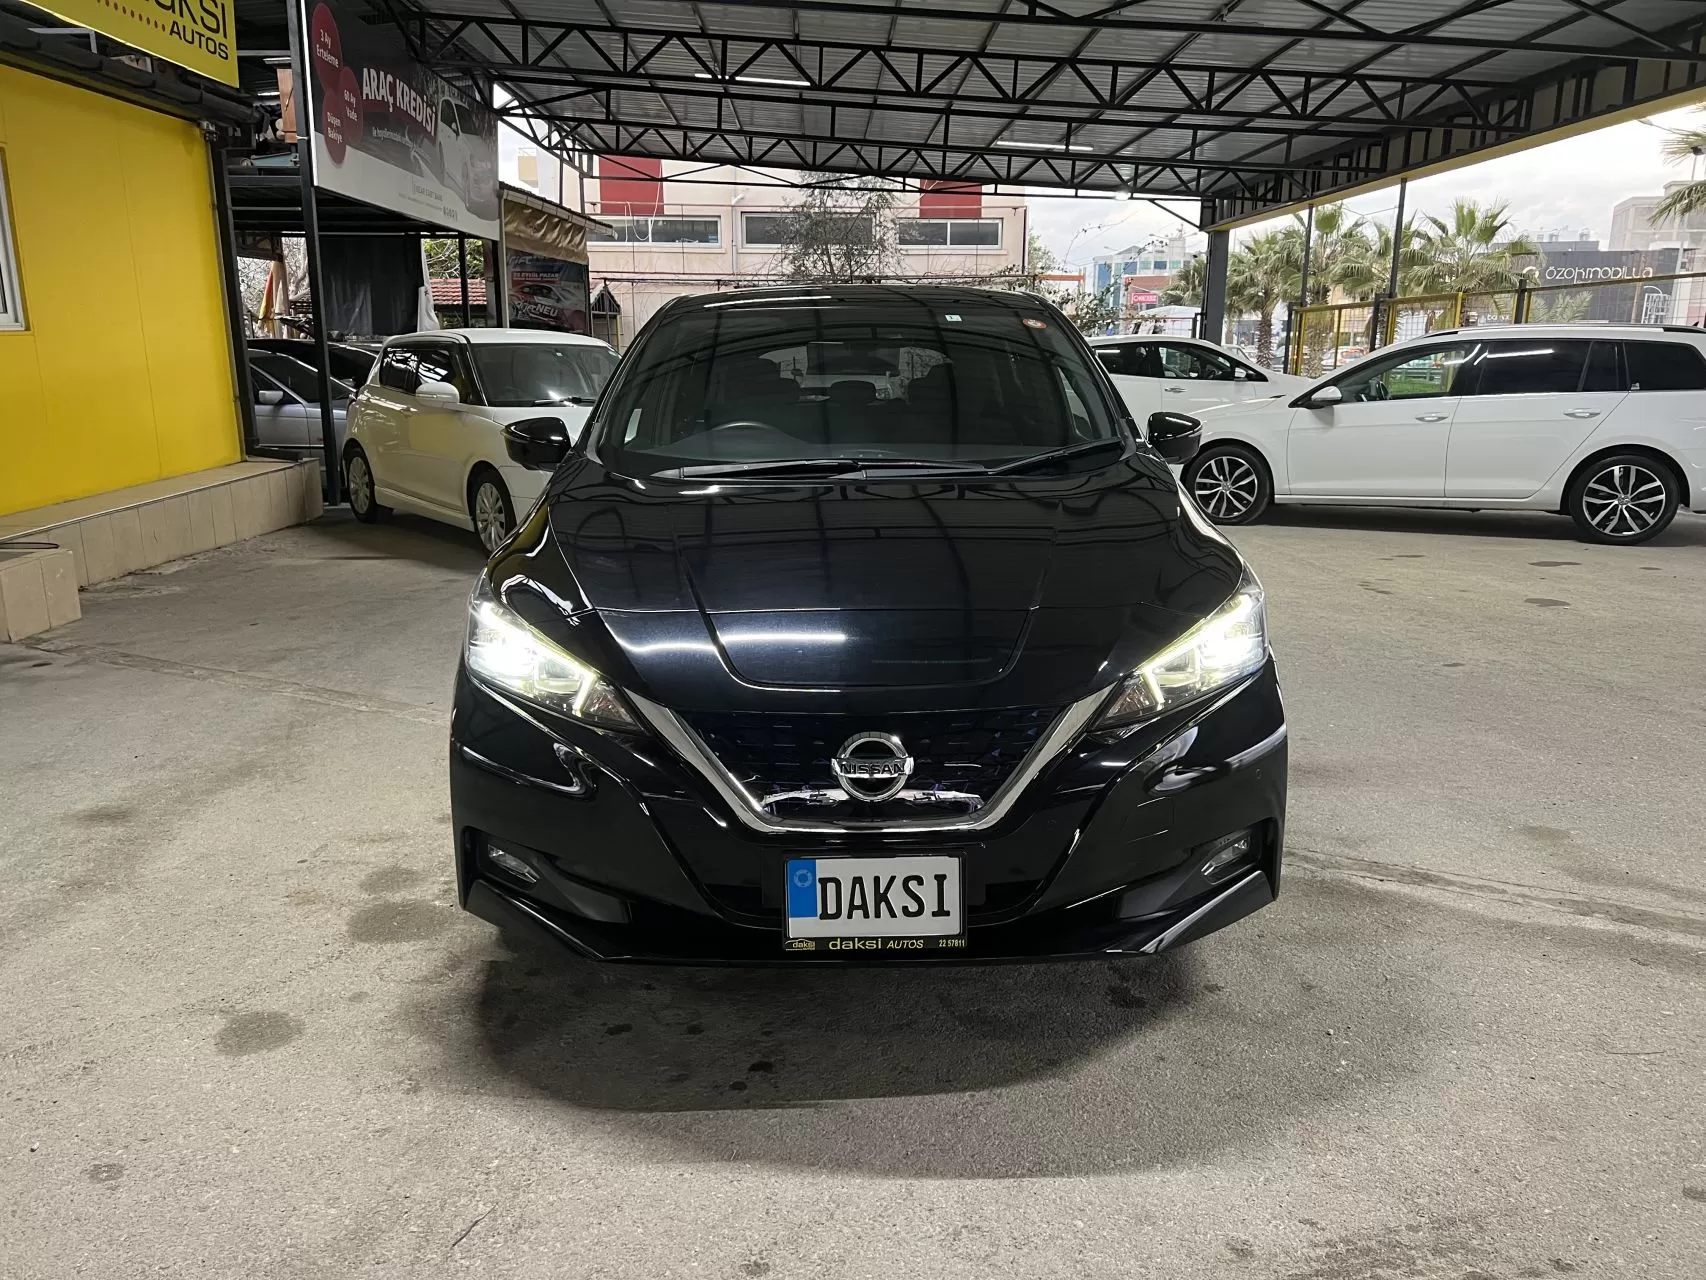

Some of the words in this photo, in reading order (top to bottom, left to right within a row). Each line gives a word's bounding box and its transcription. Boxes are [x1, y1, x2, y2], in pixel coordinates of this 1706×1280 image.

[169, 20, 229, 60] AUTOS
[320, 29, 324, 42] 3
[325, 33, 331, 49] Ay
[316, 44, 339, 68] Erteleme
[362, 67, 394, 113] ARAÇ
[396, 78, 436, 137] KREDİSİ
[327, 111, 341, 128] Düşen
[346, 105, 358, 122] Vade
[327, 127, 343, 144] Bakiye
[536, 303, 558, 317] NEU
[840, 762, 905, 775] NISSAN
[818, 874, 950, 920] DAKSI
[829, 938, 882, 950] daksi
[887, 939, 924, 949] AUTOS
[939, 939, 946, 948] 22
[947, 939, 965, 948] 57811
